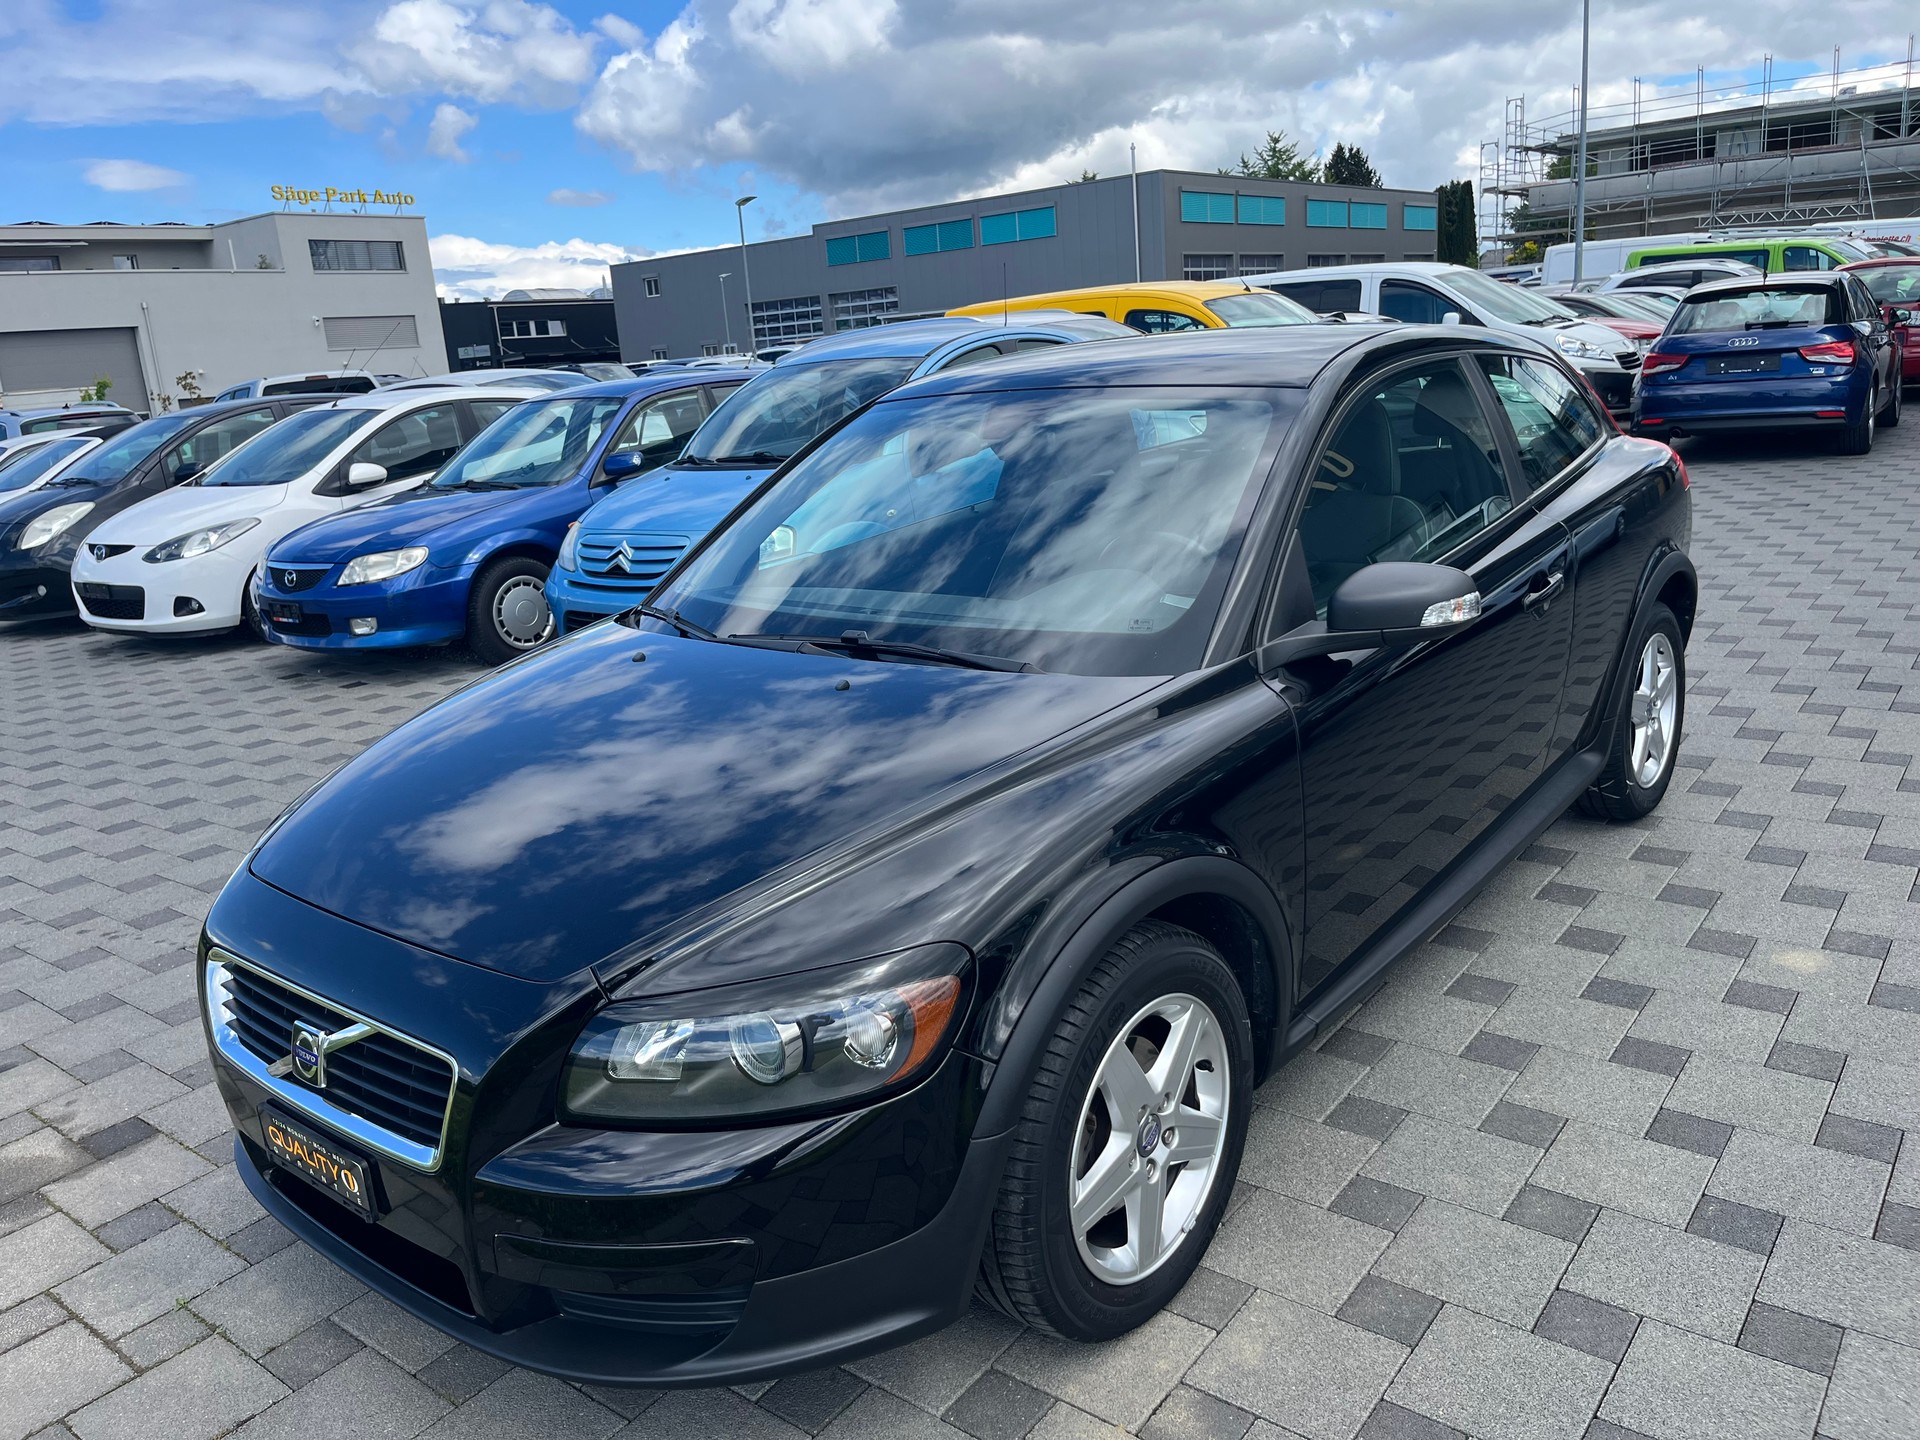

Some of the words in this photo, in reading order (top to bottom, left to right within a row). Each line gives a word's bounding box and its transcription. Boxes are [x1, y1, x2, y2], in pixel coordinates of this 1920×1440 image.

[271, 185, 320, 205] Säge
[325, 187, 367, 203] Park
[373, 189, 415, 206] Auto
[268, 1125, 339, 1181] QUALITY
[273, 1145, 363, 1206] GARANTIE
